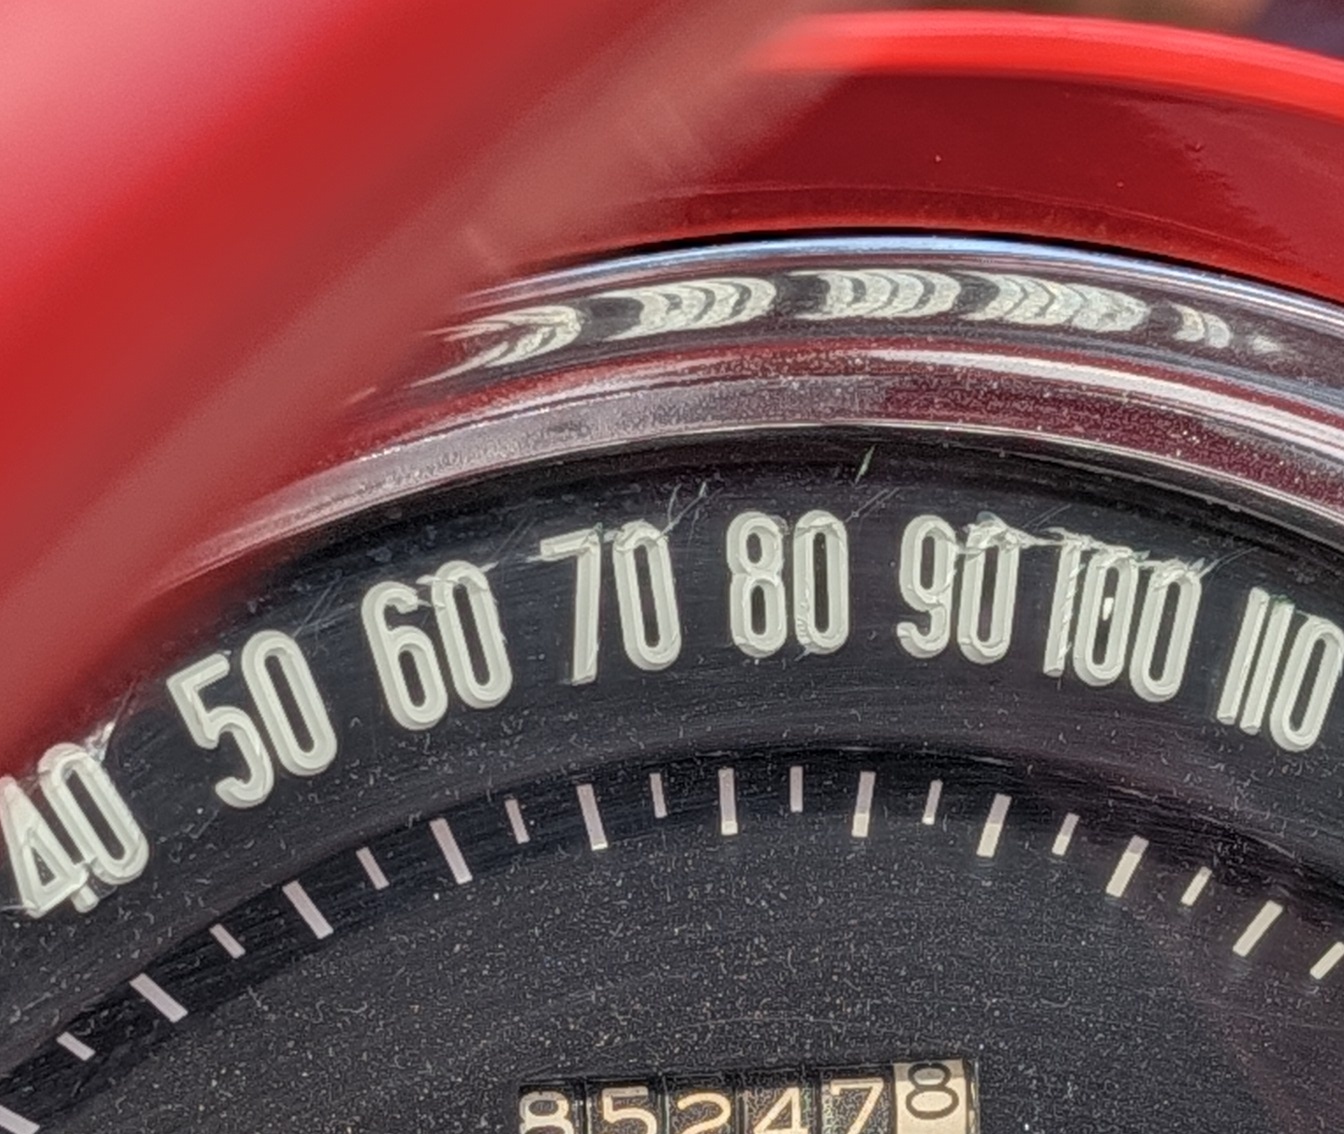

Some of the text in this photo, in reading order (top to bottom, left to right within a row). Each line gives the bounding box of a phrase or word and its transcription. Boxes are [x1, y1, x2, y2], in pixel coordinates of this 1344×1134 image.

[361, 560, 513, 730] 60
[539, 520, 682, 685] 70
[726, 510, 849, 656] 80
[896, 513, 1020, 664] 90
[1043, 530, 1202, 701] 100
[166, 630, 338, 808] 50
